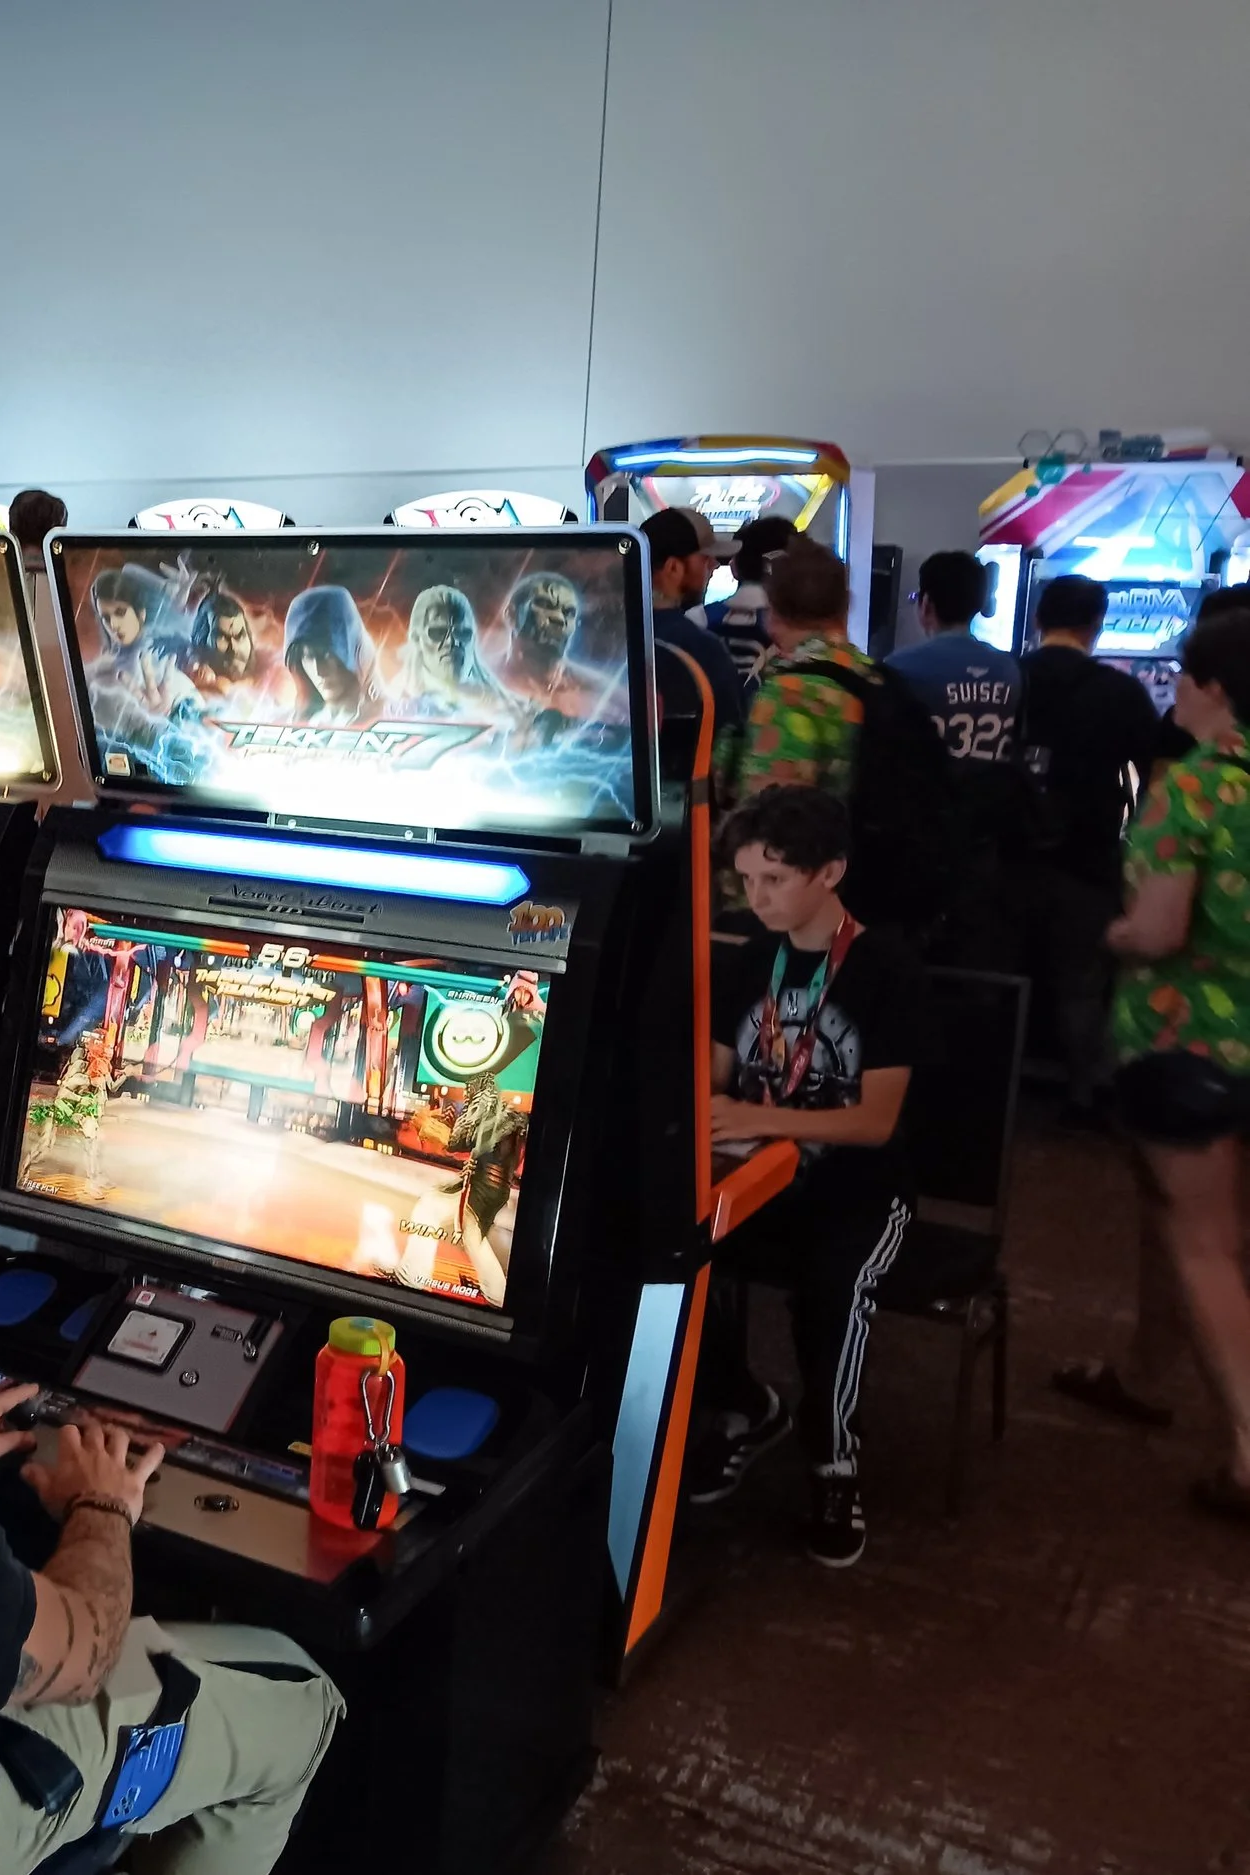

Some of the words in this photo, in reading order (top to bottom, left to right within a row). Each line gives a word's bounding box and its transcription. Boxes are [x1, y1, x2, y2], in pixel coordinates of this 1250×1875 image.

[946, 682, 1011, 705] SUISEI
[218, 722, 405, 755] TEKKEN
[370, 720, 494, 771] 7
[508, 900, 565, 932] 100
[452, 1283, 480, 1299] MODE
